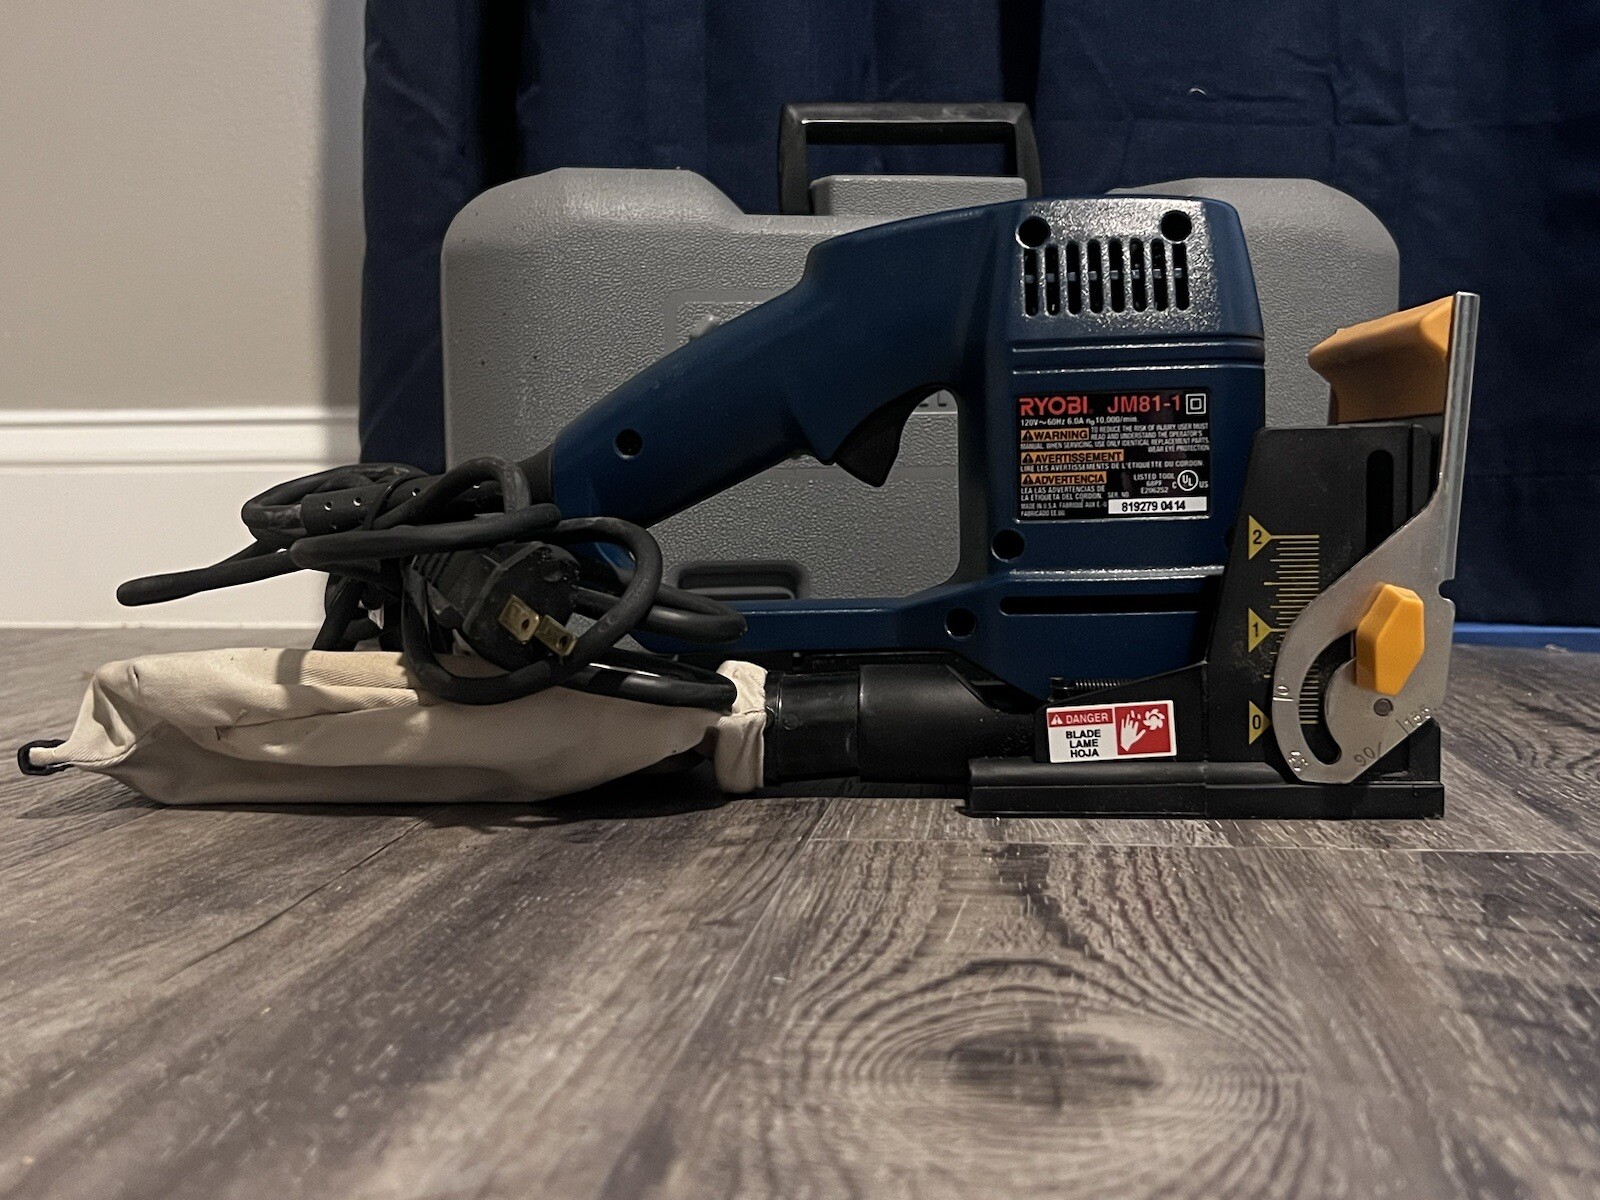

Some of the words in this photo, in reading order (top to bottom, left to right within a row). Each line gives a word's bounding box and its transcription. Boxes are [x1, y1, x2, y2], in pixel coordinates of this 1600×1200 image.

[1019, 396, 1088, 416] RYOBI
[1107, 394, 1181, 414] JM81-1
[1067, 417, 1084, 425] 6.0A
[1034, 430, 1088, 440] WARNING
[1120, 431, 1156, 439] UNDERSTAND
[1121, 439, 1150, 447] IDENTICAL
[1151, 438, 1190, 446] REPLACEMENT
[1035, 452, 1122, 463] AVERTISSEMENT
[1036, 464, 1049, 472] LES
[1050, 463, 1109, 472] AVERTISSEMENTS
[1111, 462, 1119, 470] DE
[1164, 460, 1174, 468] DU
[1034, 474, 1104, 485] ADVERTENCIA
[1133, 473, 1157, 481] LISTED
[1048, 486, 1095, 494] ADVERTENCIAS
[1122, 501, 1158, 512] 819279
[1252, 530, 1262, 545] 2
[1253, 624, 1259, 638] 1
[1065, 712, 1109, 724] DANGER
[1251, 714, 1261, 730] 0
[1065, 729, 1101, 739] BLADE
[1069, 739, 1099, 749] LAME
[1070, 749, 1099, 758] HOJA
[1353, 746, 1375, 767] 90
